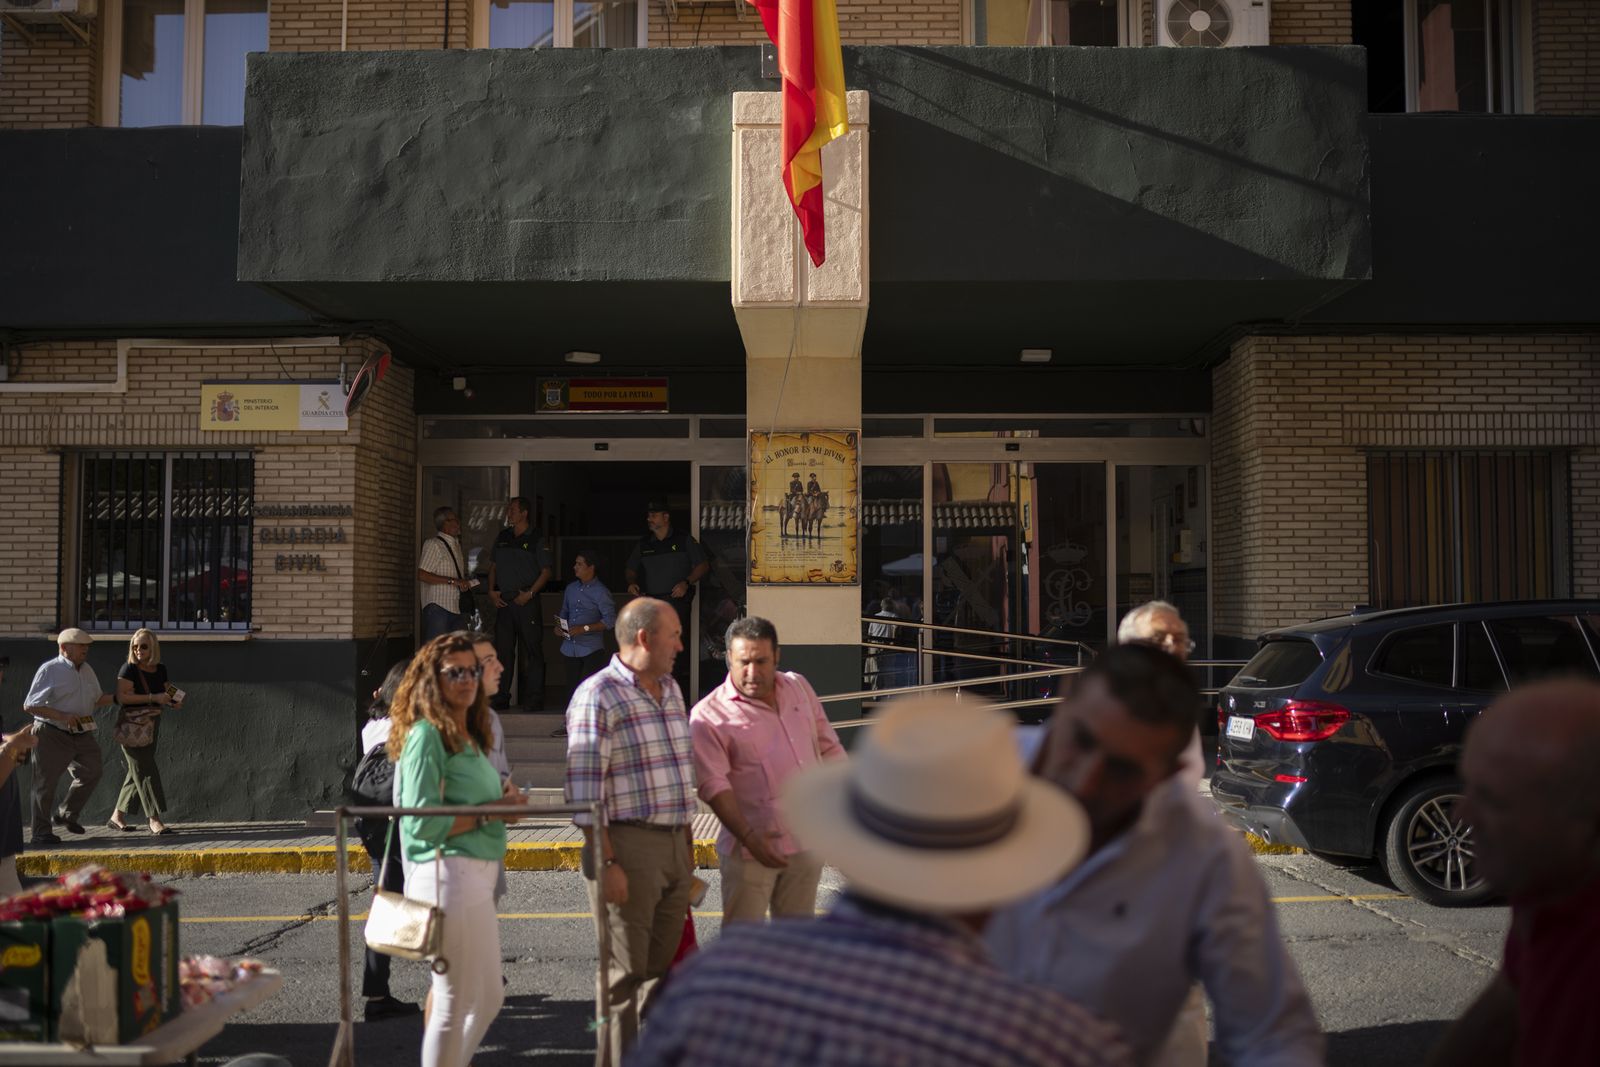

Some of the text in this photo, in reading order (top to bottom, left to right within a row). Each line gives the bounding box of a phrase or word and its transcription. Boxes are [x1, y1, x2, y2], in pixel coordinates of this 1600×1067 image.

[584, 391, 654, 399] TODO POR LA PATRIA
[764, 445, 847, 464] EL HONOR ES MI DIVISA
[260, 527, 347, 544] GUARDIA
[274, 553, 327, 571] CIVIL
